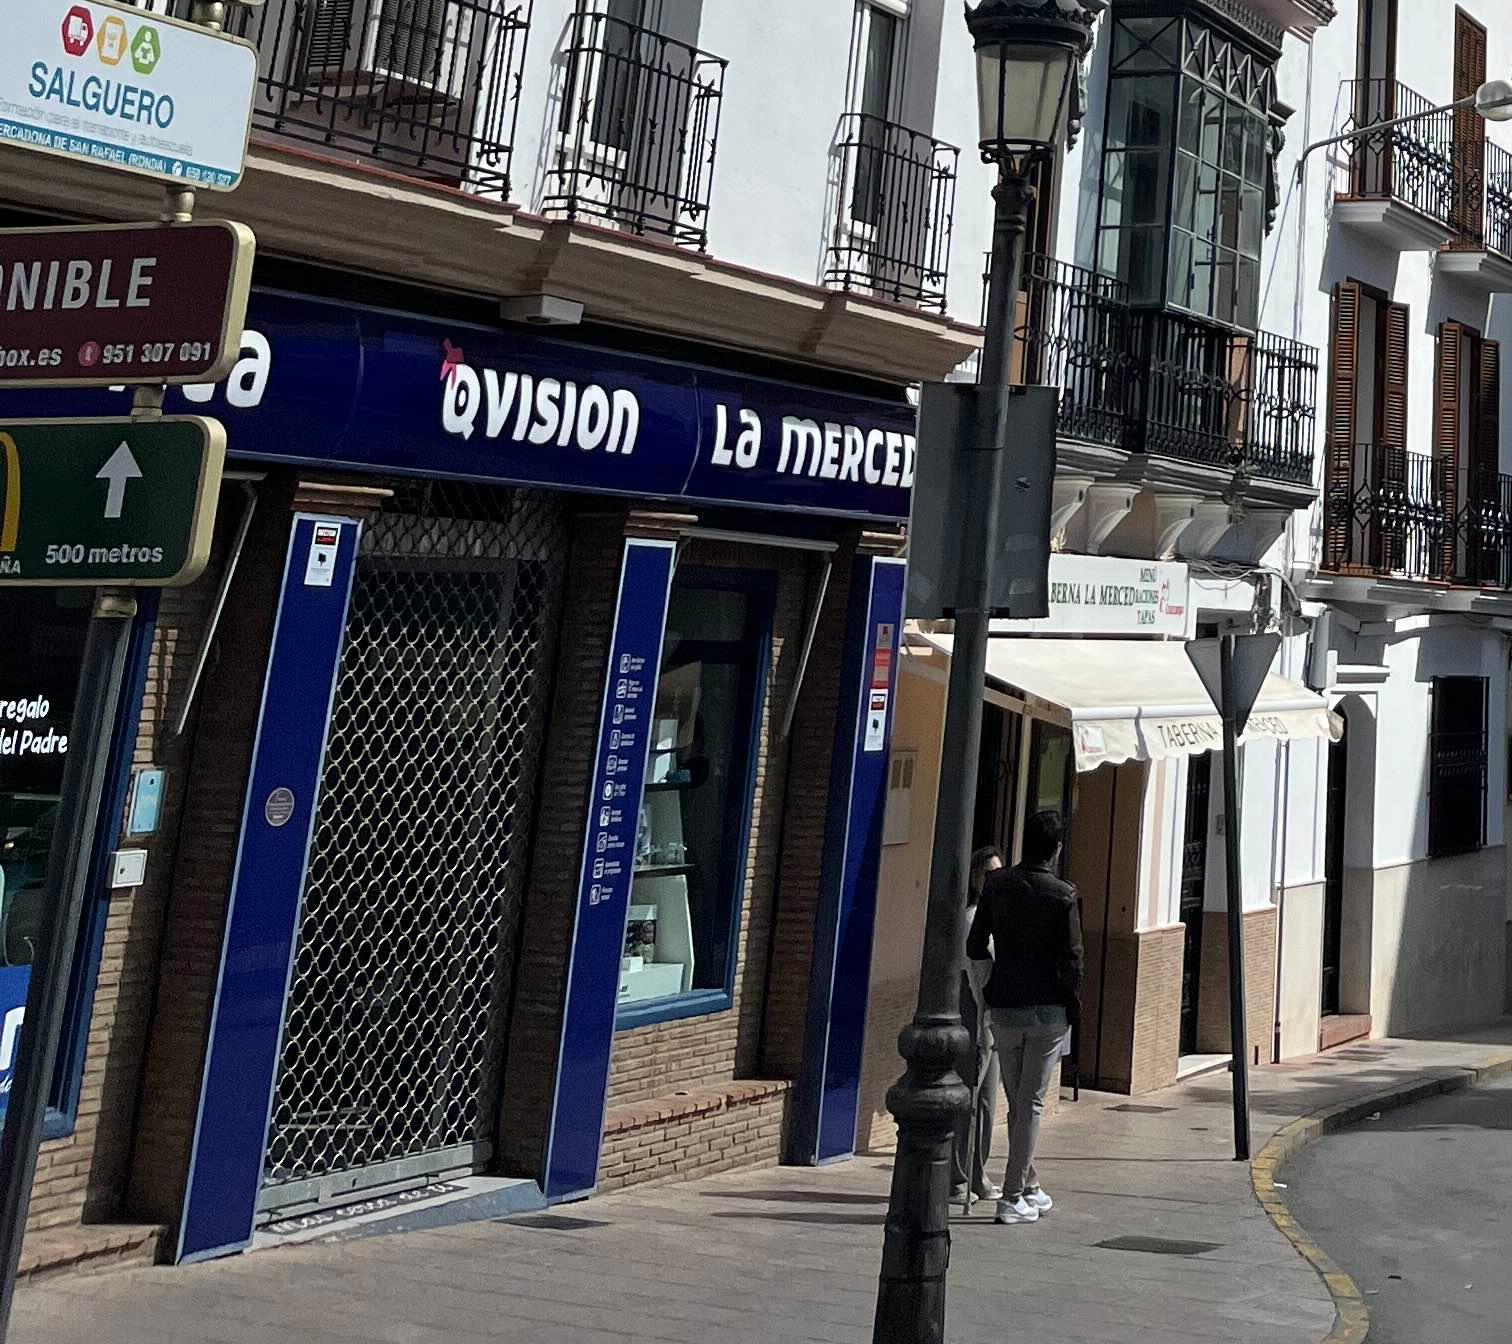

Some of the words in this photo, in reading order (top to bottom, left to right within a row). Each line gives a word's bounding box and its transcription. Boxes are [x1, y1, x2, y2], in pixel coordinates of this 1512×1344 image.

[28, 61, 174, 129] SALGUERO
[53, 134, 67, 150] DE
[69, 139, 89, 154] SAN
[91, 144, 125, 165] RAFAEL
[0, 257, 157, 311] NIBLE
[102, 344, 135, 363] 951
[140, 343, 175, 362] 307
[179, 342, 211, 361] 091
[0, 555, 21, 574] ÑA
[45, 544, 85, 564] 500
[88, 544, 163, 564] metros
[1048, 582, 1081, 604] BERNA
[1085, 583, 1096, 605] LA
[1100, 585, 1135, 606] MERCED
[1137, 609, 1155, 625] TAPAS
[19, 726, 68, 755] Padre
[1157, 720, 1221, 749] TABERNA
